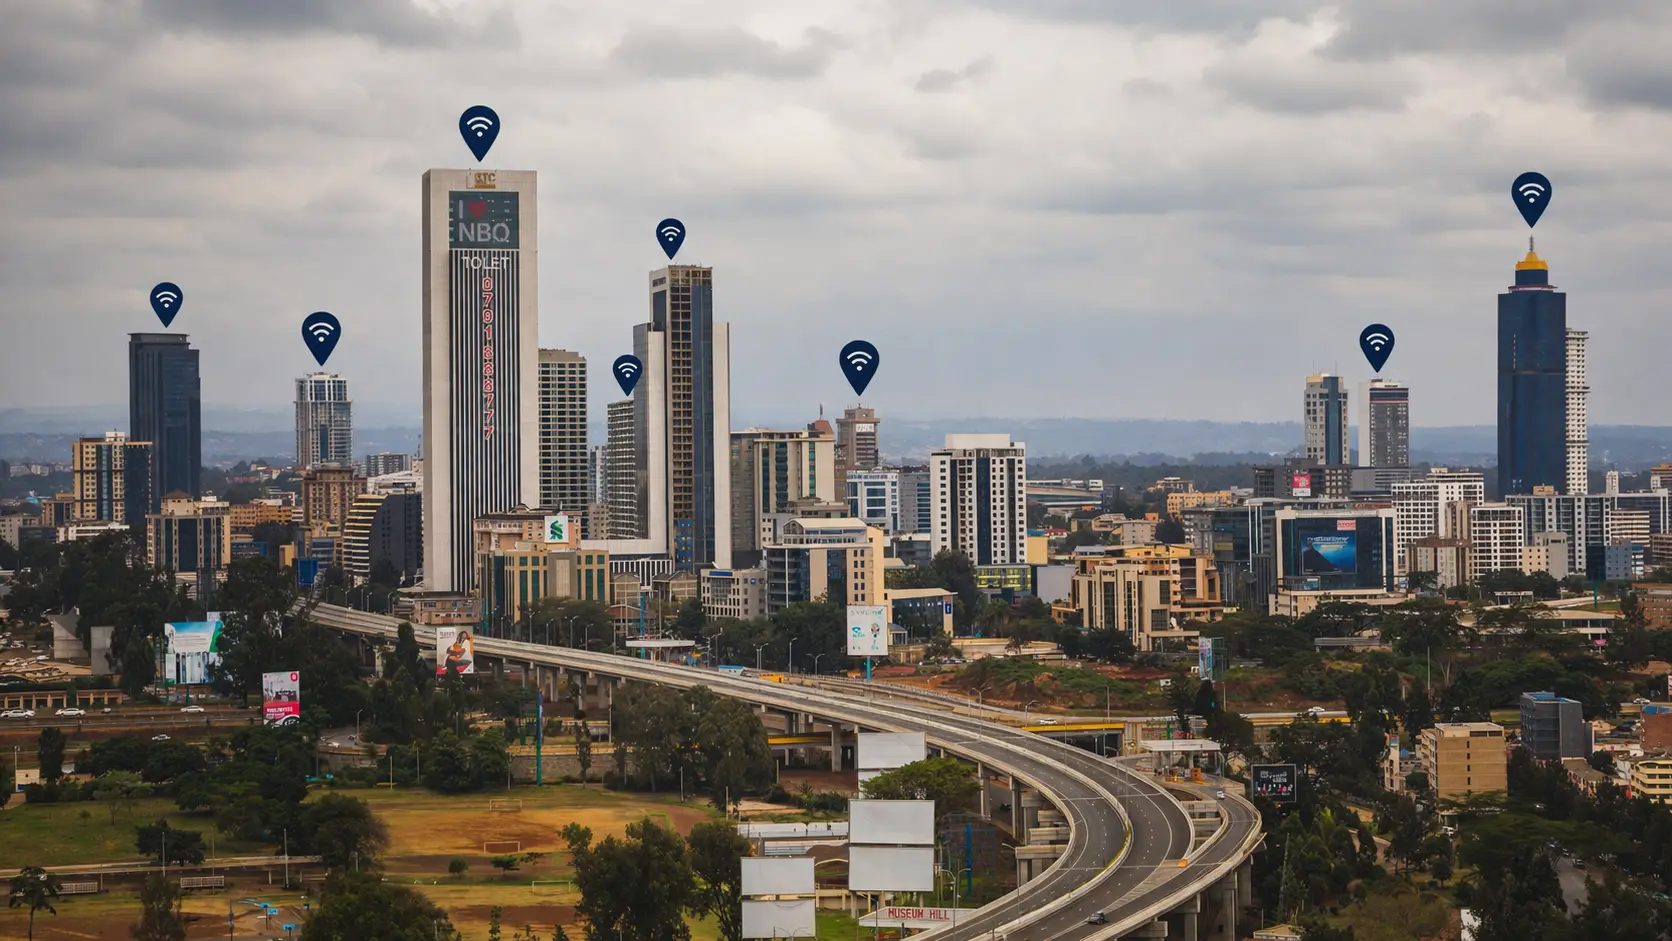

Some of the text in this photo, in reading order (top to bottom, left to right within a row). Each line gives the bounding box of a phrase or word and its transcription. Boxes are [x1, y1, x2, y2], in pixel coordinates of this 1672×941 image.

[459, 200, 464, 219] I
[888, 907, 950, 920] MUSEUM HILL
